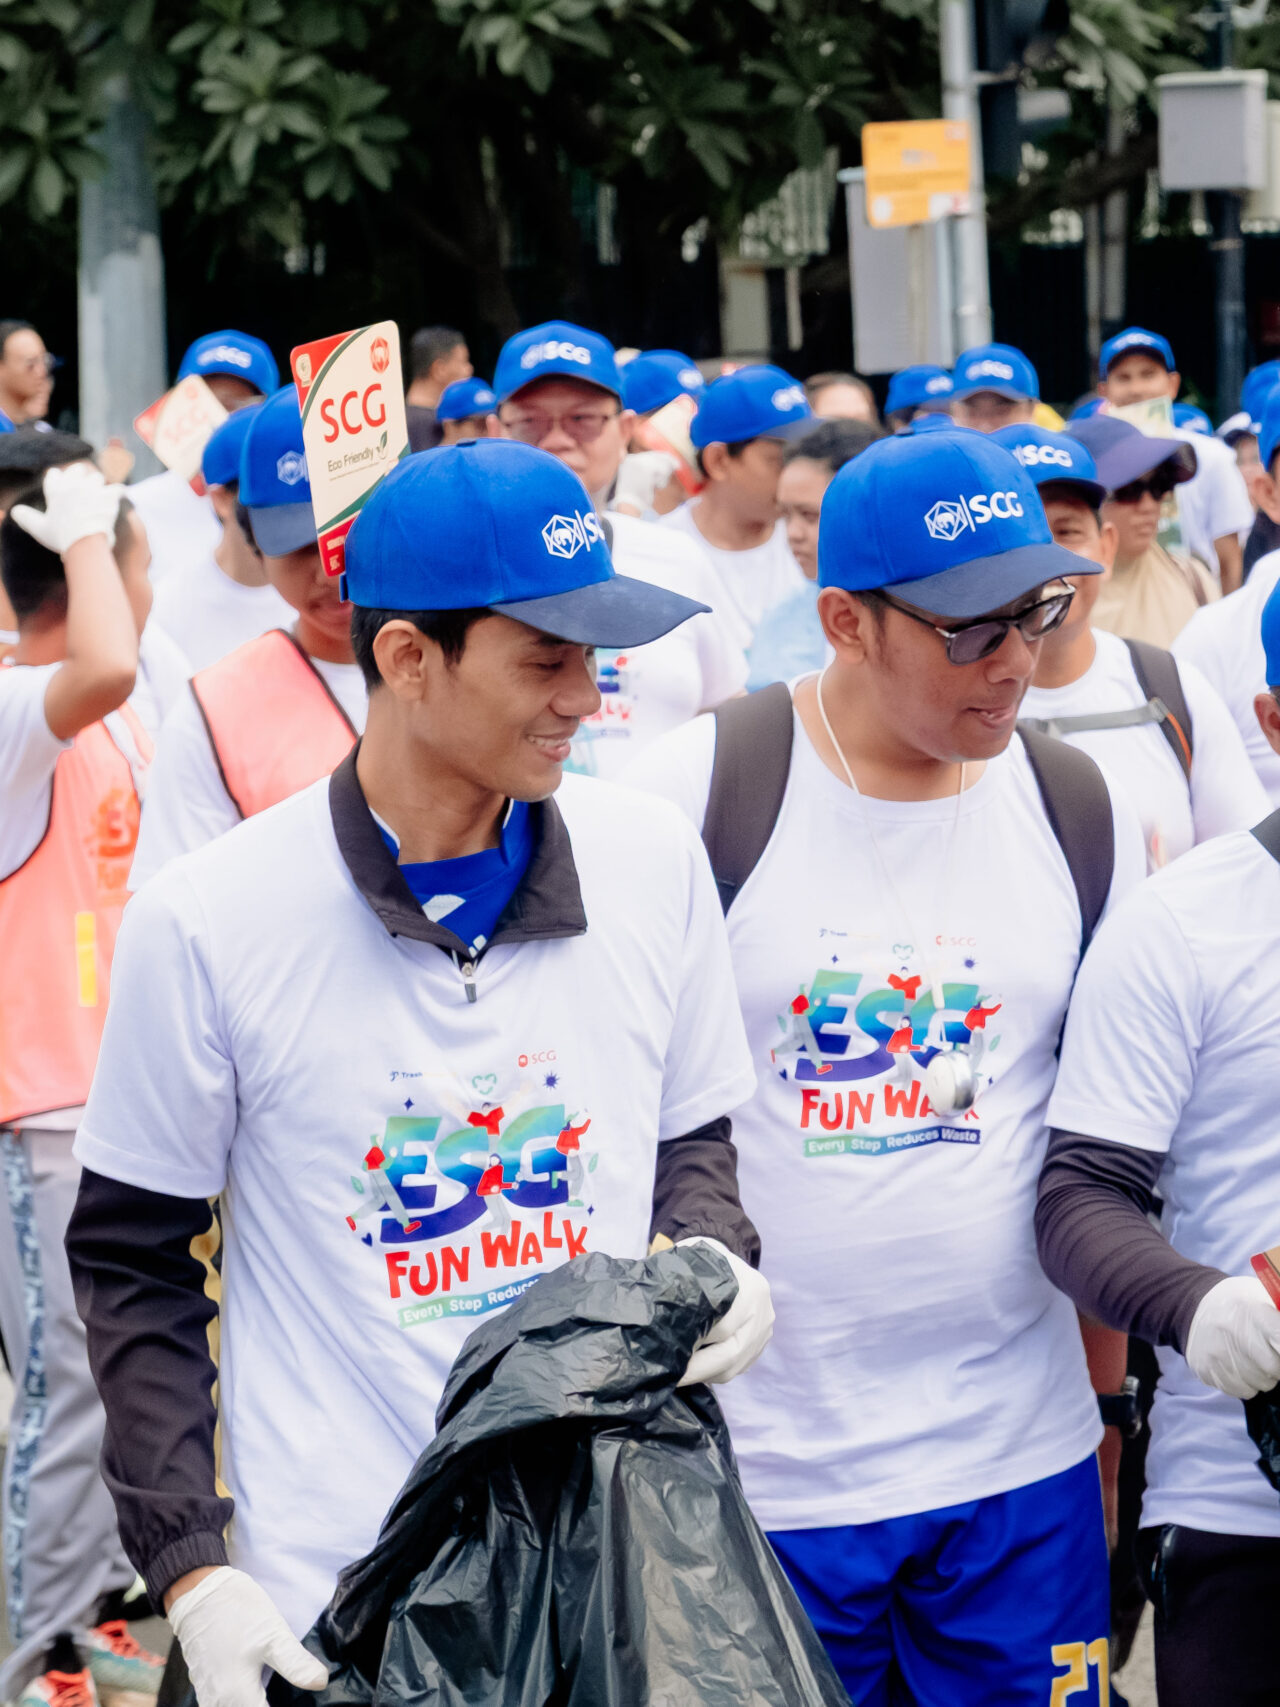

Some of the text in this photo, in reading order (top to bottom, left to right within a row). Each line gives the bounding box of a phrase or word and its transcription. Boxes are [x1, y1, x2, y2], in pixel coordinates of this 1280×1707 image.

[543, 340, 592, 365] SCG
[320, 383, 387, 443] SCG
[327, 460, 343, 472] Eco
[343, 447, 374, 466] Friendly
[1022, 444, 1073, 468] SCG
[968, 491, 1025, 524] SCG
[530, 1050, 557, 1064] SCG
[800, 1088, 875, 1131] FUN
[808, 1128, 978, 1153] Every Step Reduces Waste
[379, 1103, 570, 1244] ESG
[385, 1211, 588, 1299] FUN WALK
[402, 1302, 444, 1323] Every
[449, 1298, 483, 1312] Step
